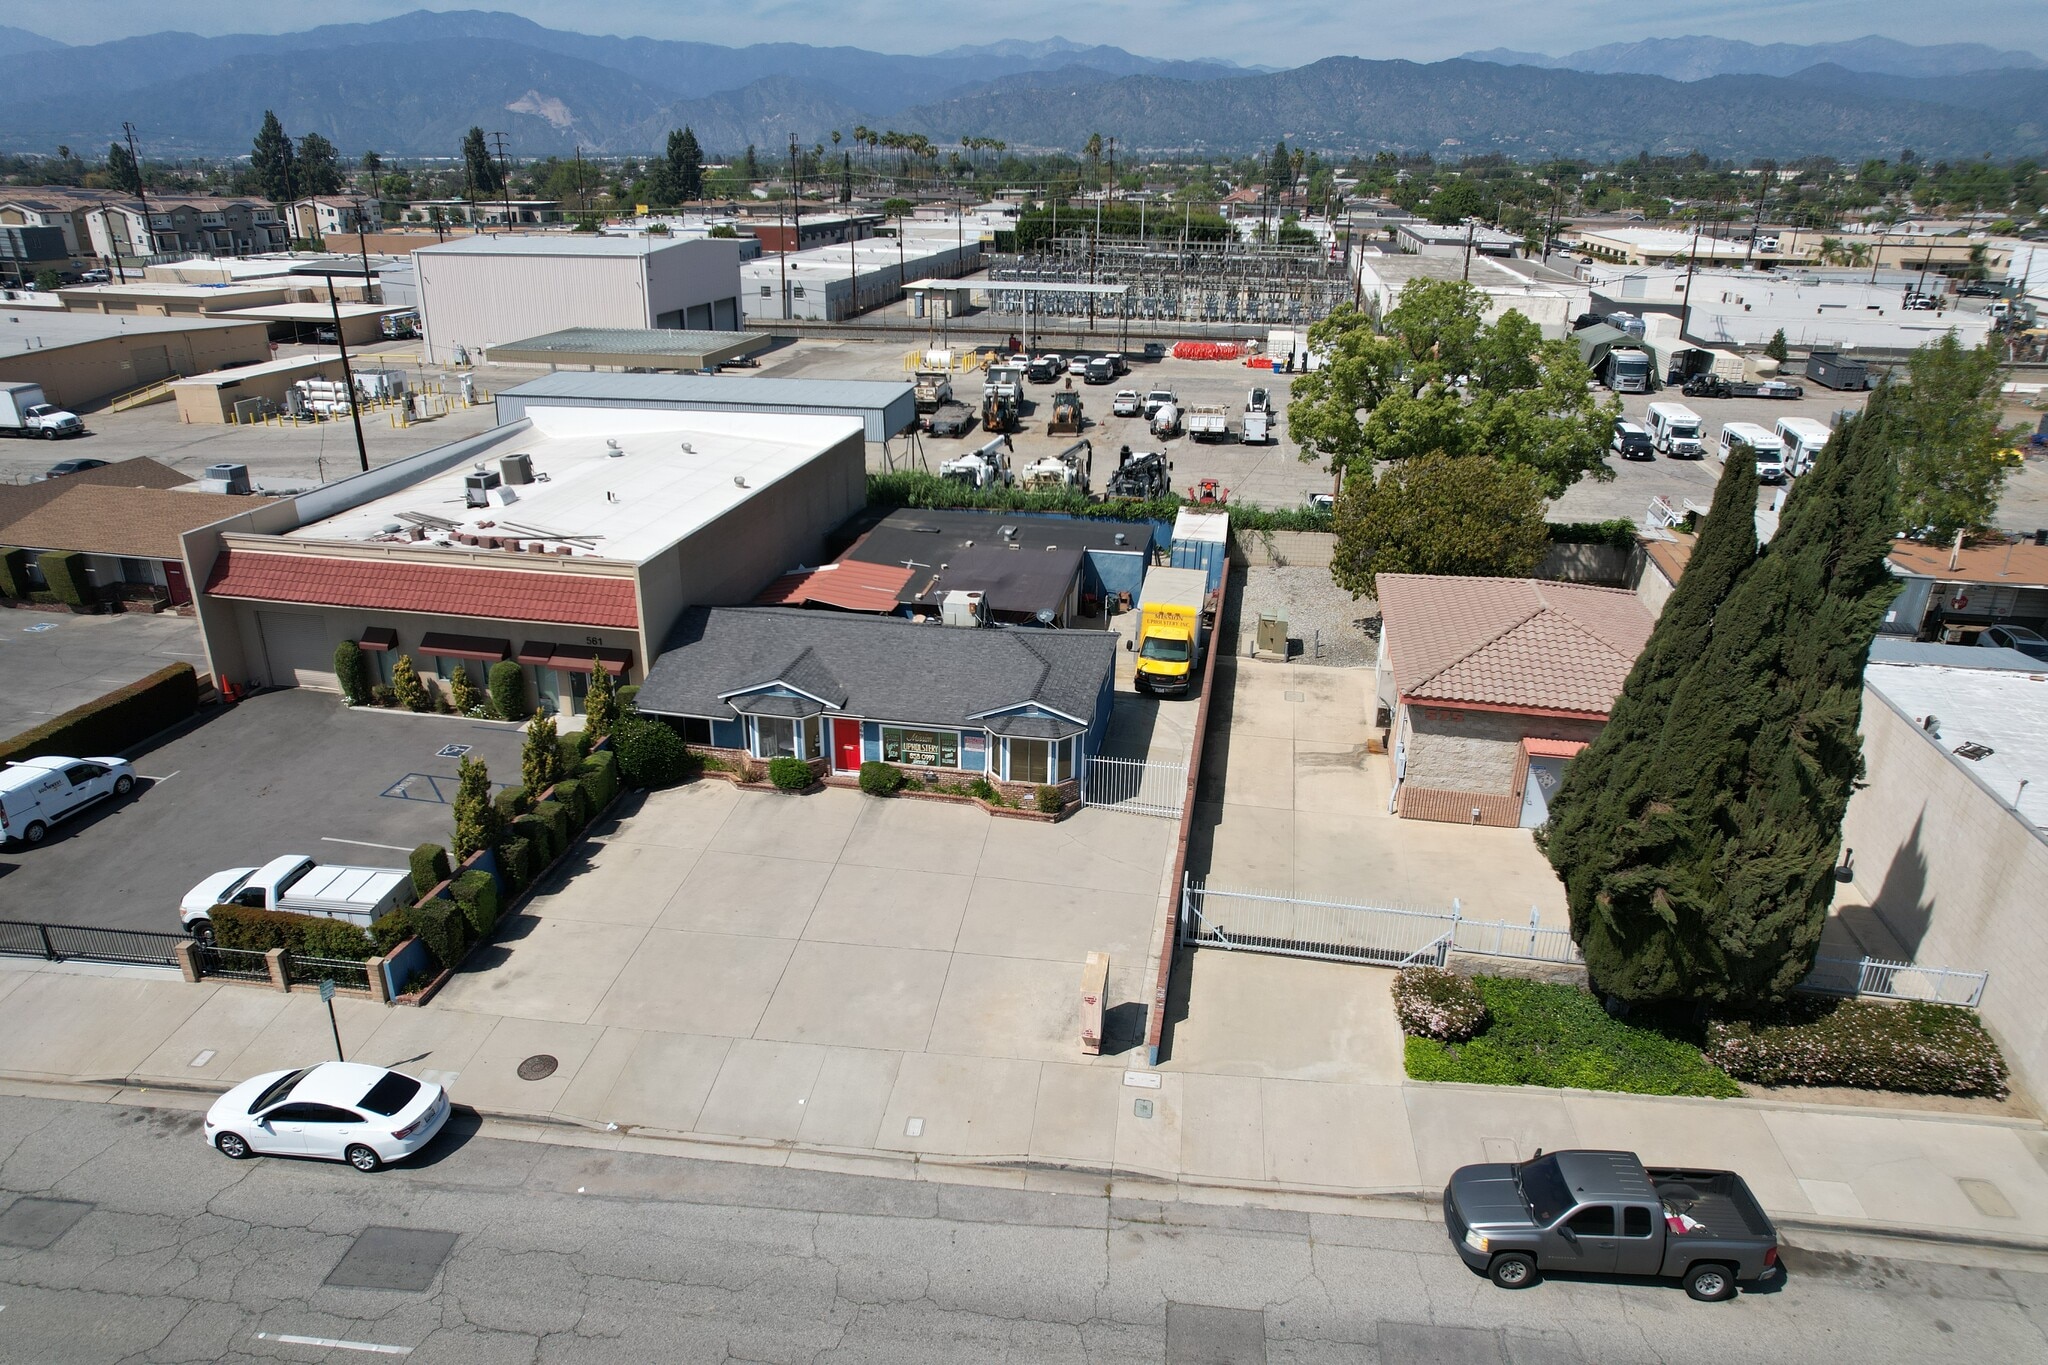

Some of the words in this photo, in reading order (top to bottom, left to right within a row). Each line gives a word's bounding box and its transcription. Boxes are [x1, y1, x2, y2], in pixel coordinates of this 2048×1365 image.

[1155, 613, 1183, 621] MISSION
[586, 636, 603, 646] 561
[1424, 710, 1464, 722] 575
[903, 742, 939, 753] UPHOLSTERY
